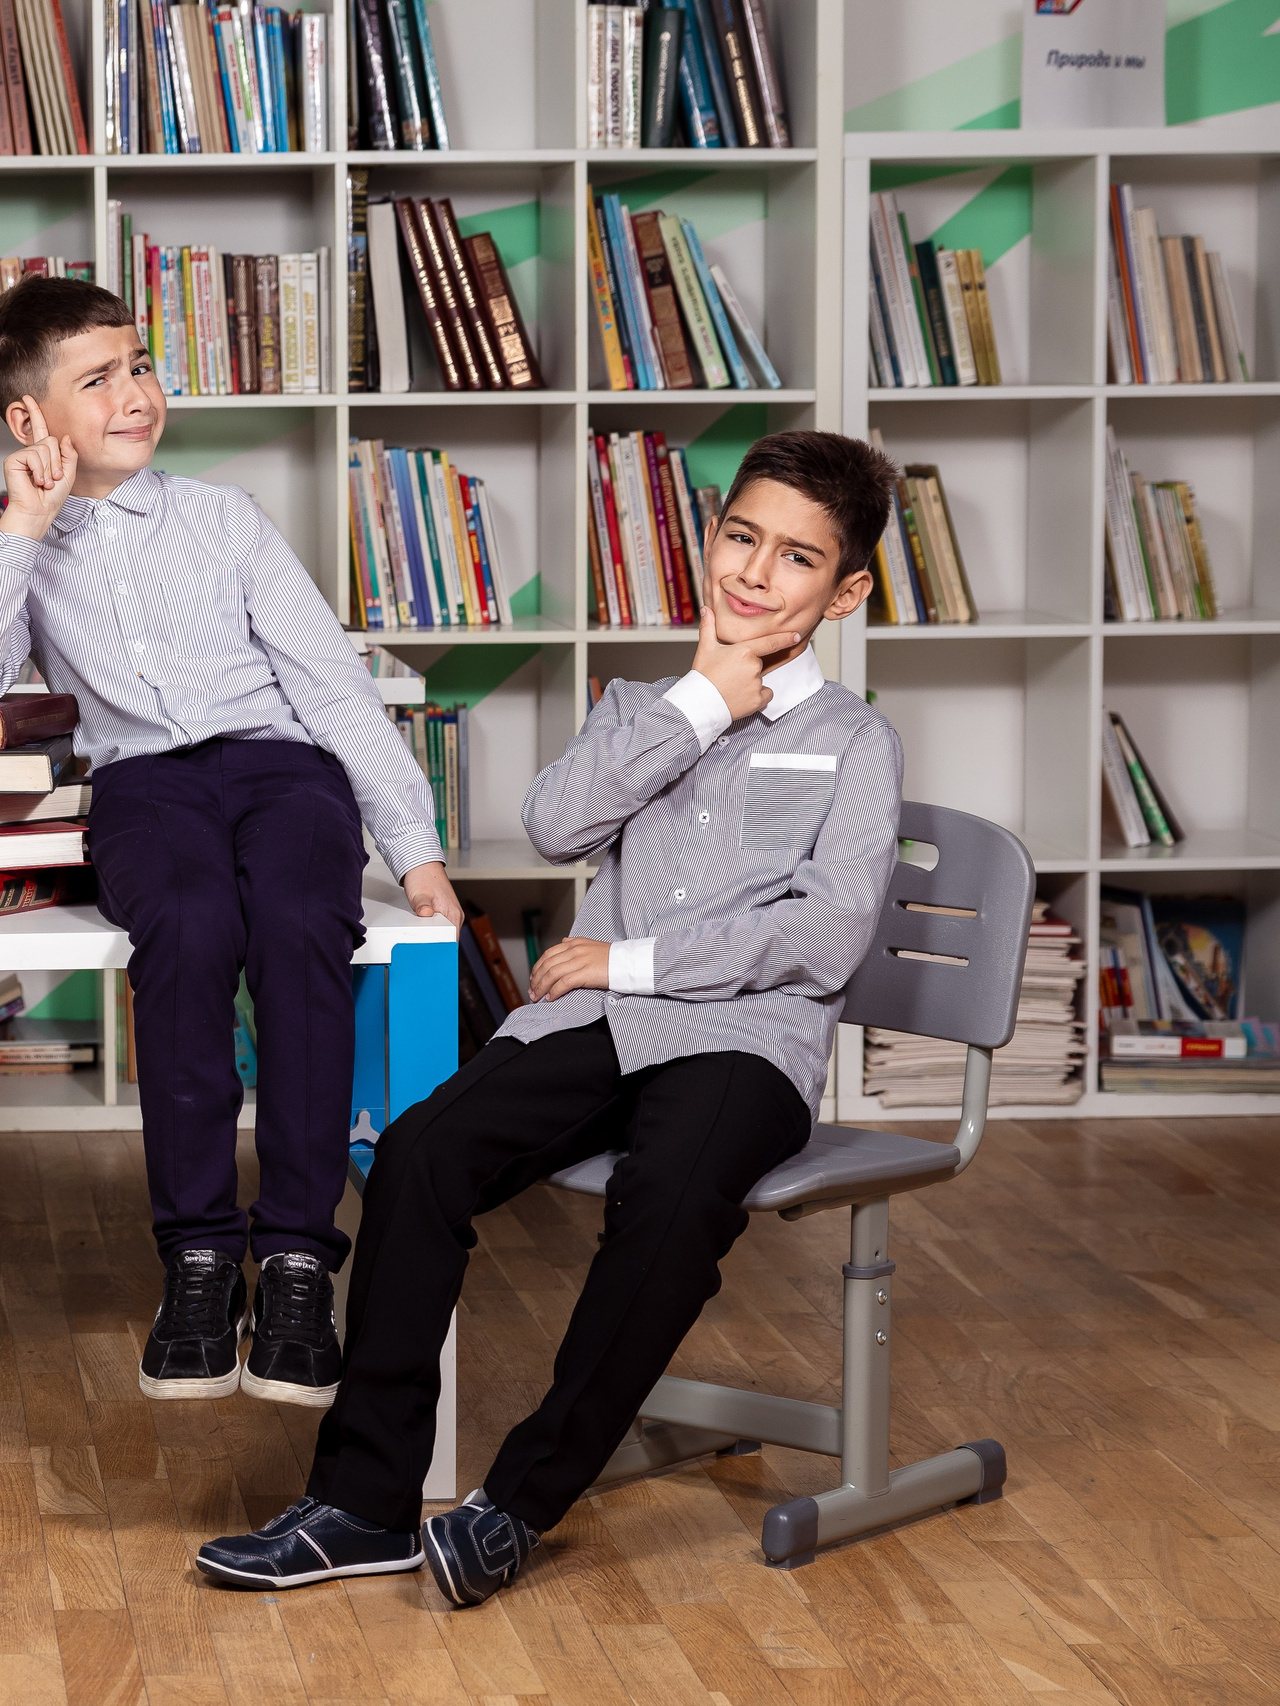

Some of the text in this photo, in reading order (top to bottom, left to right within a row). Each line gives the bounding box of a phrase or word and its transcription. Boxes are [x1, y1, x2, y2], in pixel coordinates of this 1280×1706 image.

[1046, 49, 1146, 71] Природа и мы
